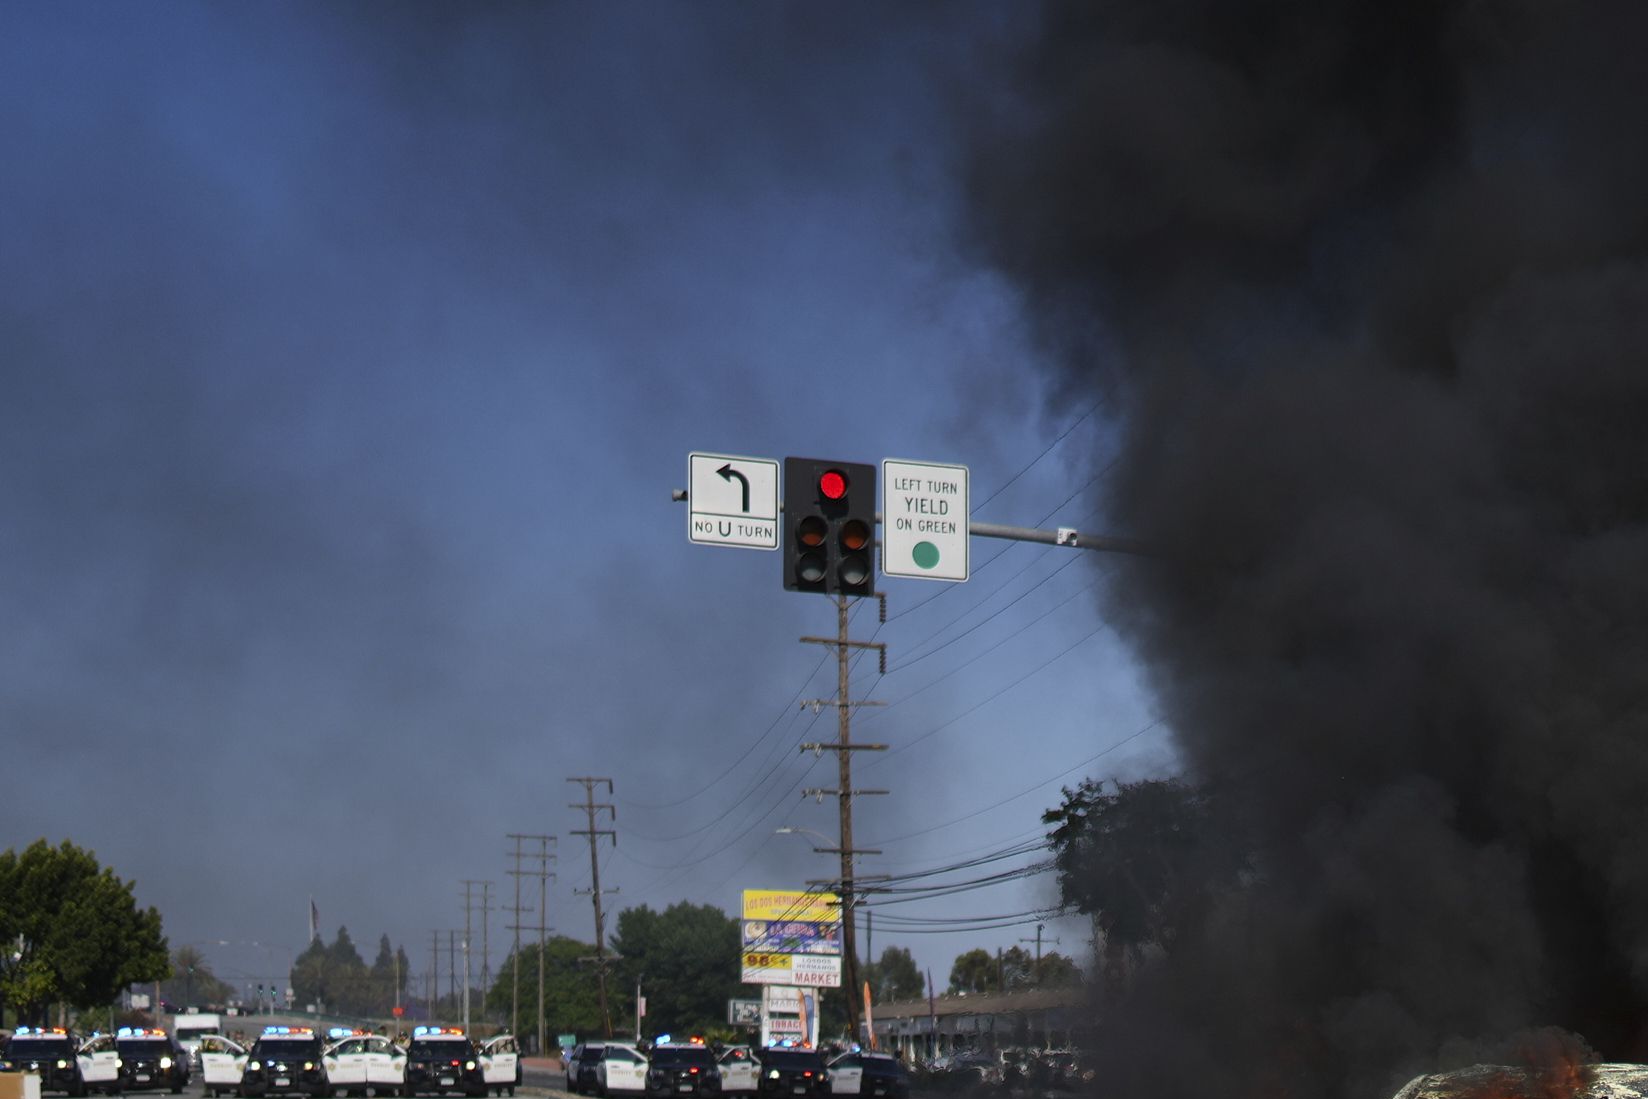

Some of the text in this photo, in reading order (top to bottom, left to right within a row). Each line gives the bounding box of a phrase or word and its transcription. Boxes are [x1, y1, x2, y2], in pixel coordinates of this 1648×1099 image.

[895, 478, 957, 494] LEFT TURN
[905, 496, 948, 515] YIELD
[695, 521, 772, 538] NO U TURN
[896, 518, 956, 534] ON GREEN
[795, 973, 838, 985] MARKET
